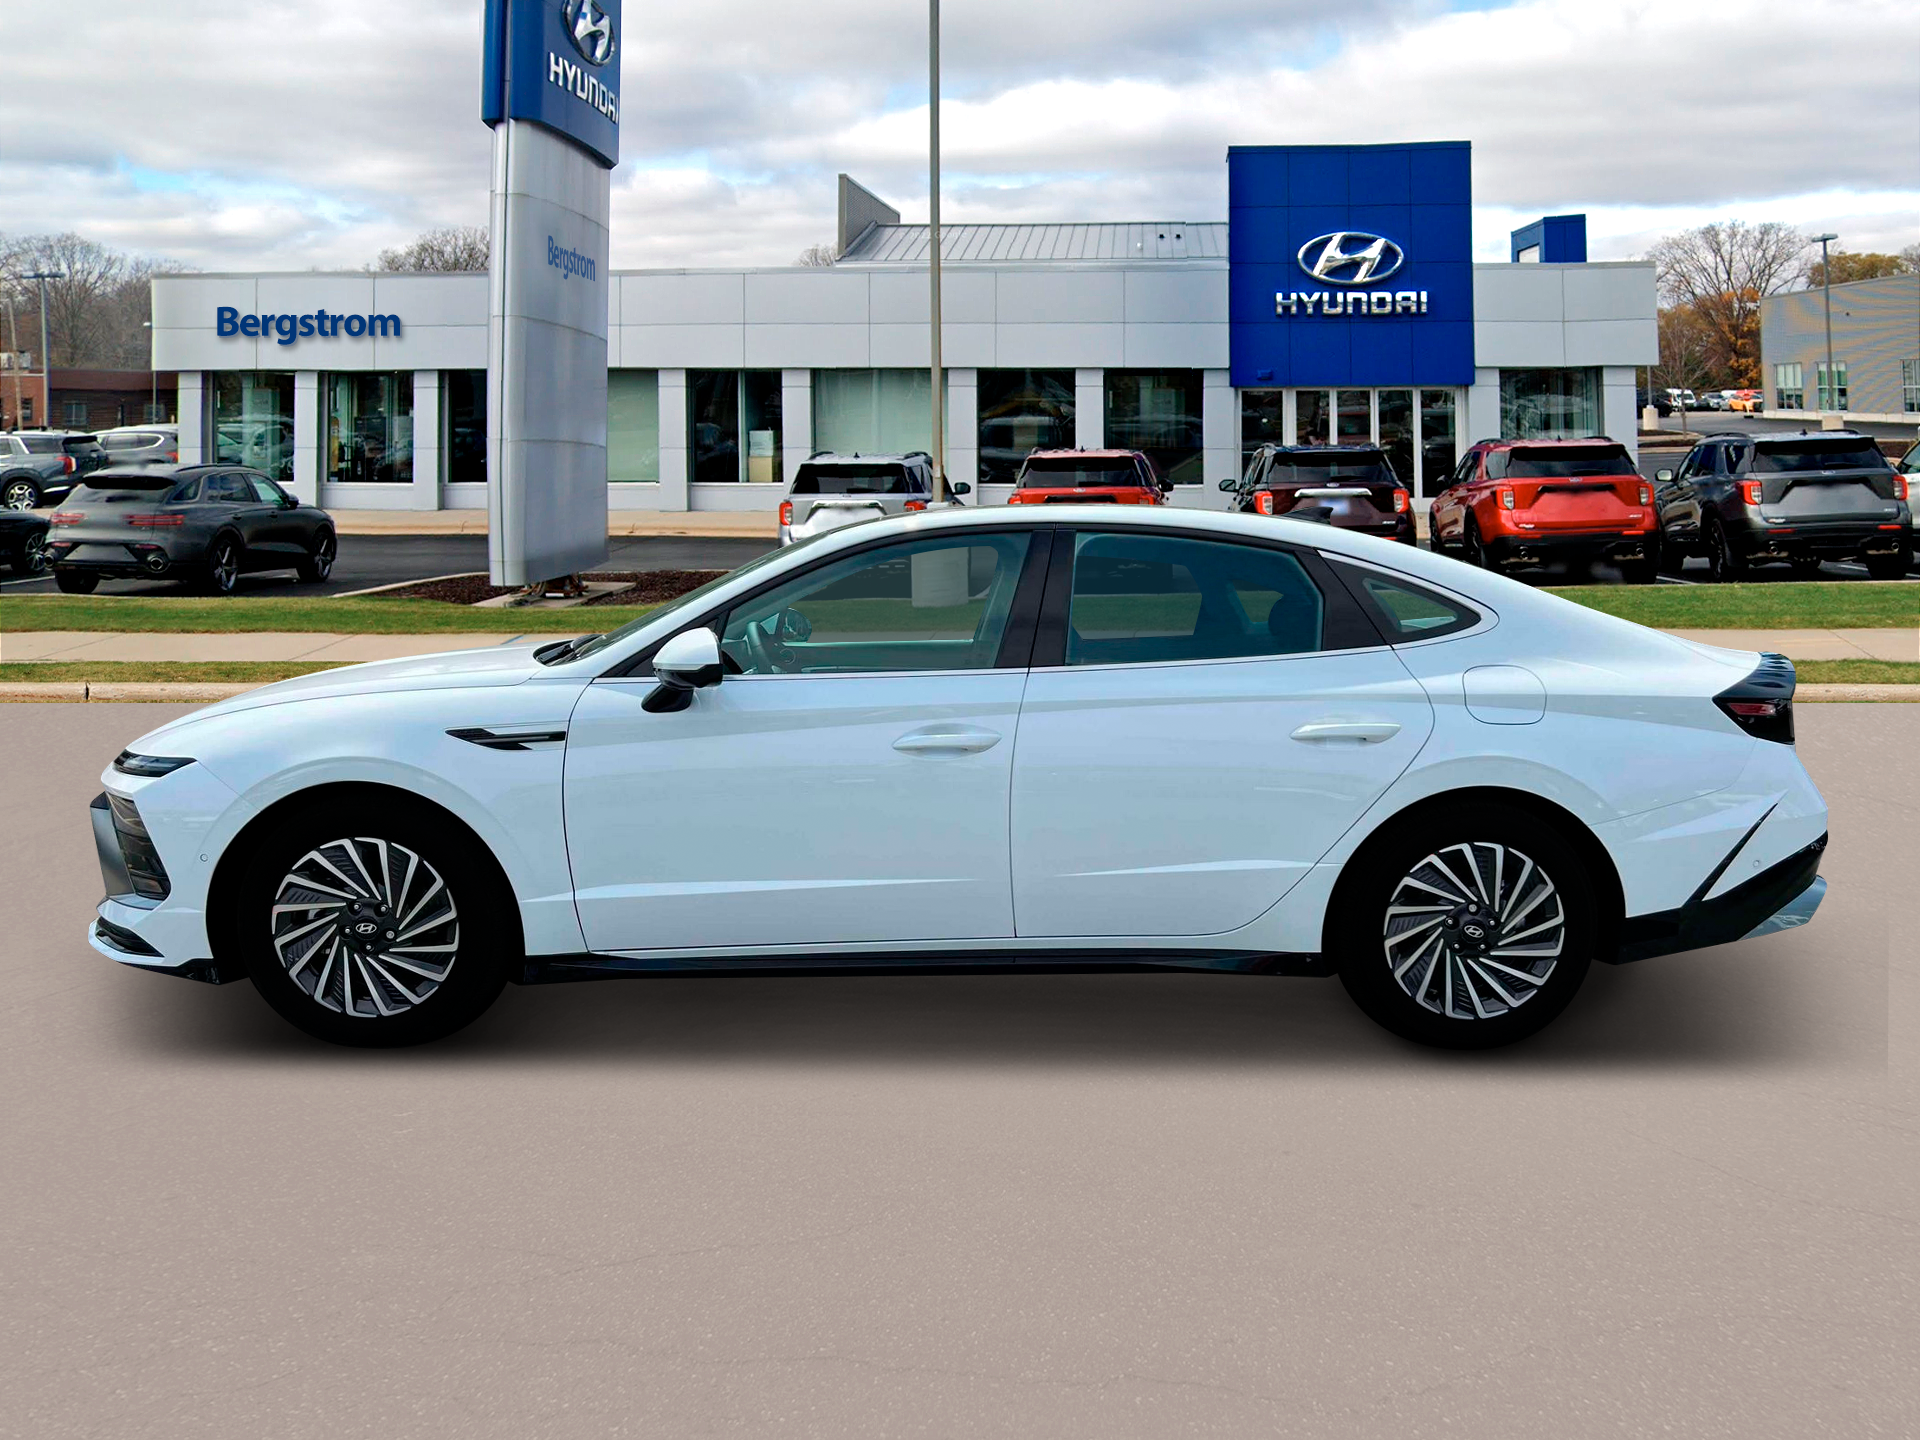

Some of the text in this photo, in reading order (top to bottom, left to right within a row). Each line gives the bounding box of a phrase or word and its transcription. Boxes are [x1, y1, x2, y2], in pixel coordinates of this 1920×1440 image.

[549, 52, 618, 124] HYUNDAI
[547, 235, 596, 282] Bergstrom
[1276, 291, 1428, 315] HYUNDAI
[216, 306, 402, 346] Bergstrom
